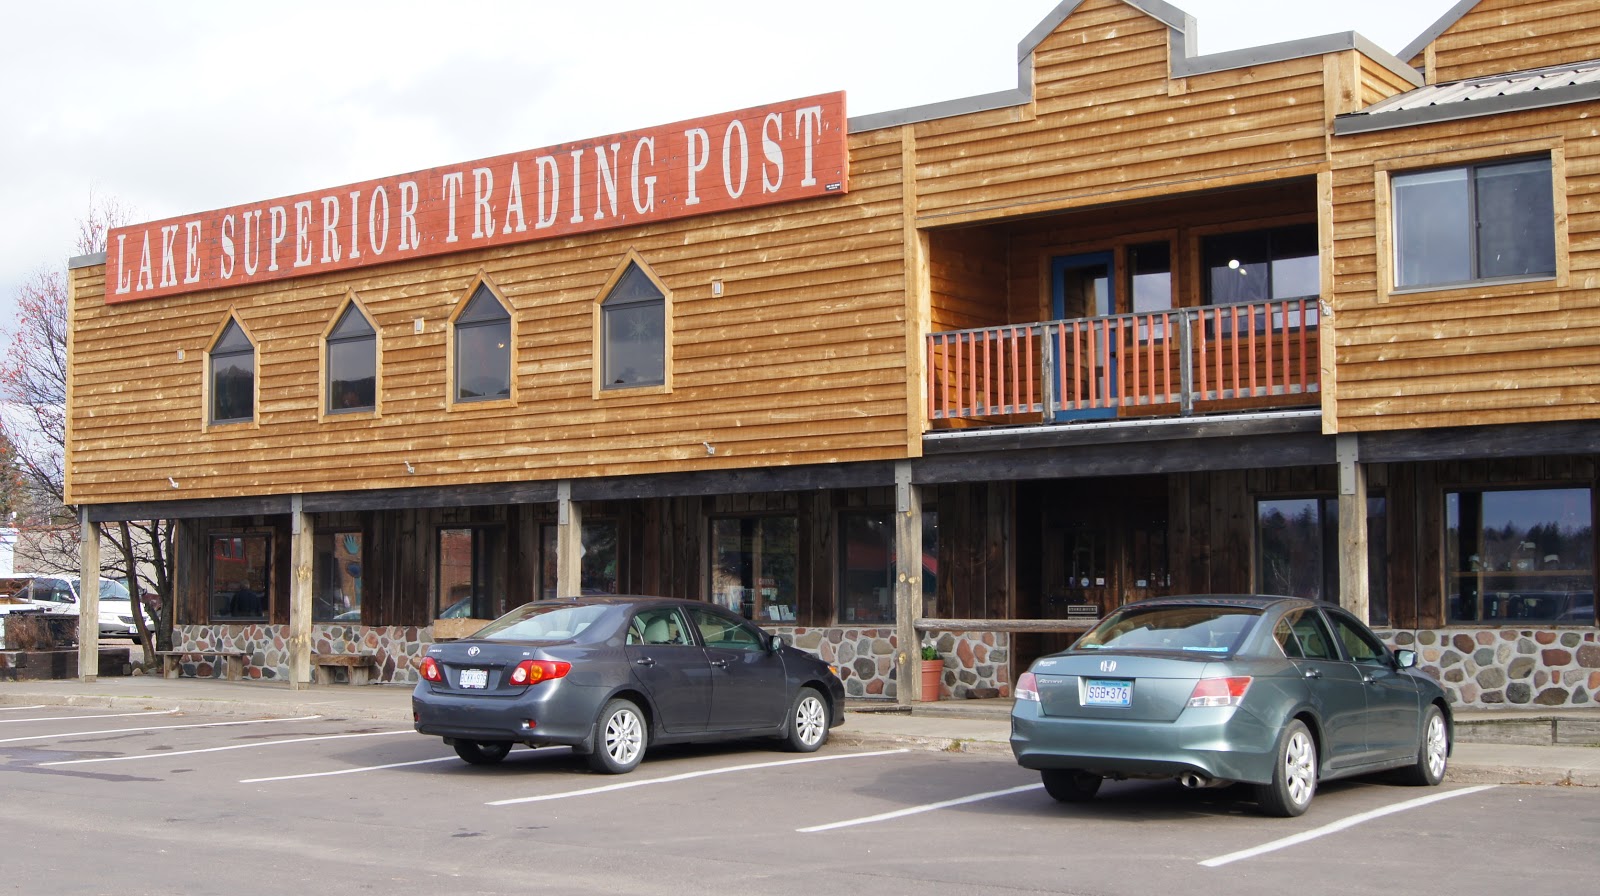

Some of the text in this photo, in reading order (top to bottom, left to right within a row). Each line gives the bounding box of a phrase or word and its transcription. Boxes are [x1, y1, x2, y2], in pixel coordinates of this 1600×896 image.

[115, 105, 823, 295] LAKE SUPERIOR TRADING POST
